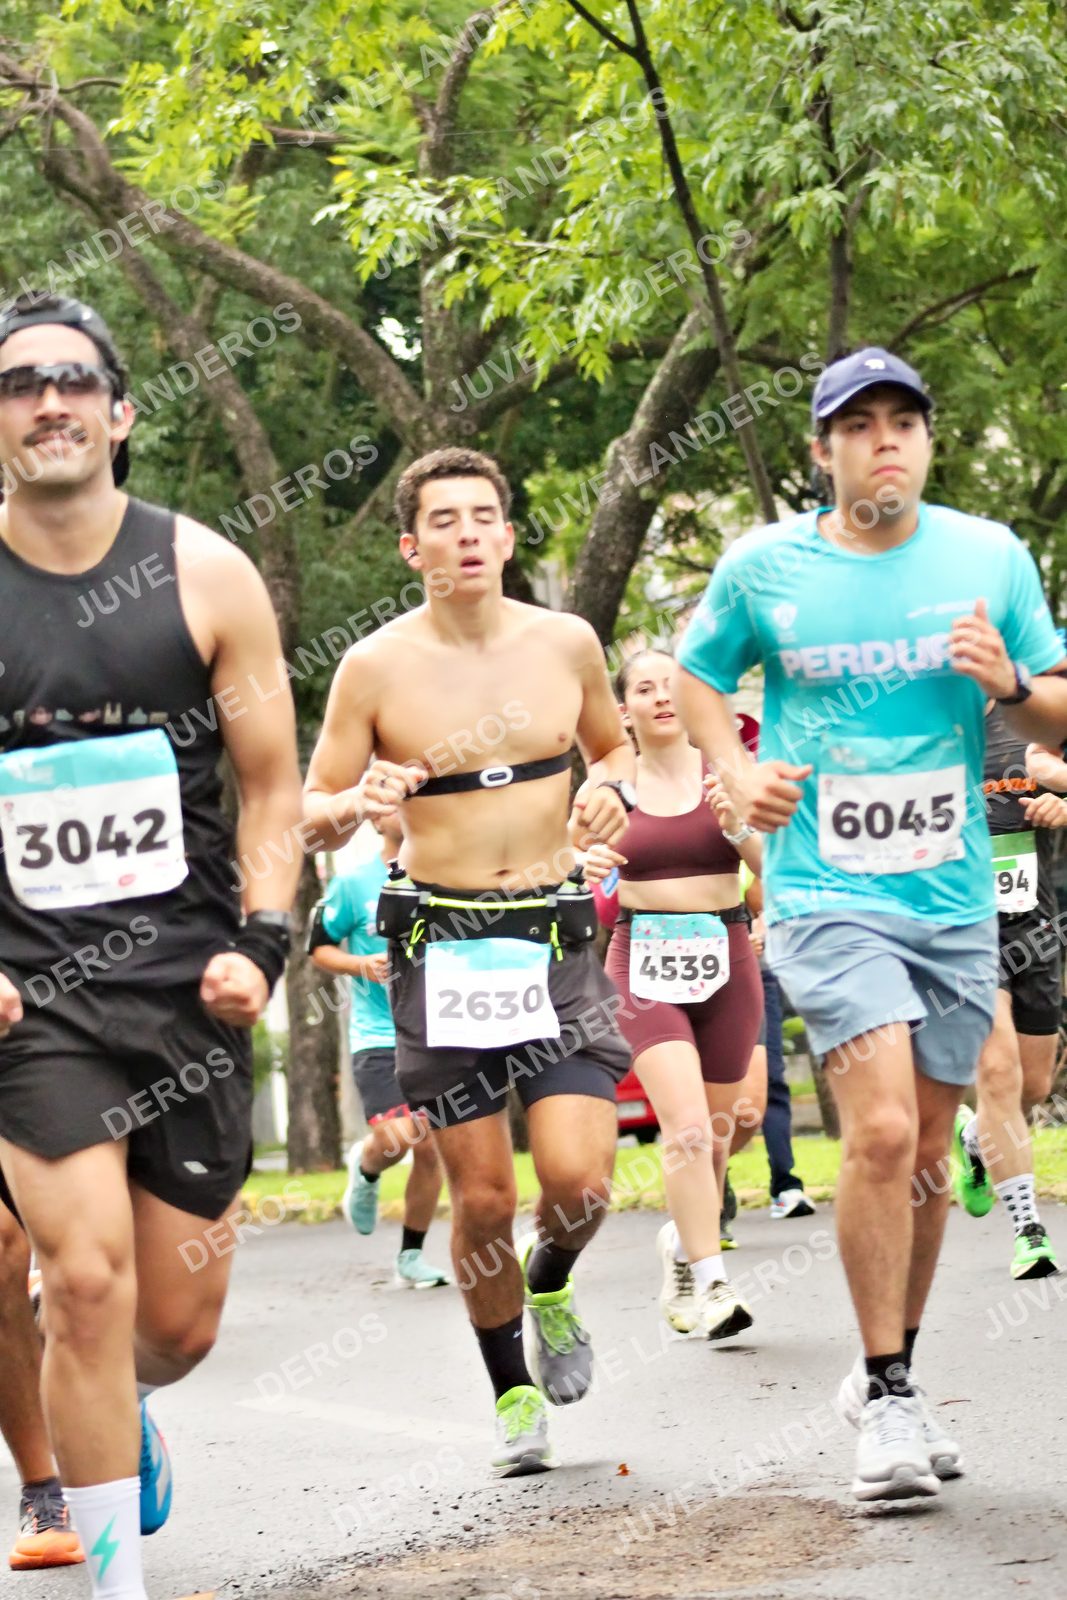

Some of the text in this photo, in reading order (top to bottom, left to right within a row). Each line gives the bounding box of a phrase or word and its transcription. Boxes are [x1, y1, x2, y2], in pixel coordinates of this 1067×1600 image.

[778, 633, 957, 679] PERDUR
[832, 793, 954, 840] 6045
[16, 808, 169, 869] 3042
[993, 869, 1029, 895] 94
[639, 954, 719, 981] 4539
[437, 984, 544, 1021] 2630
